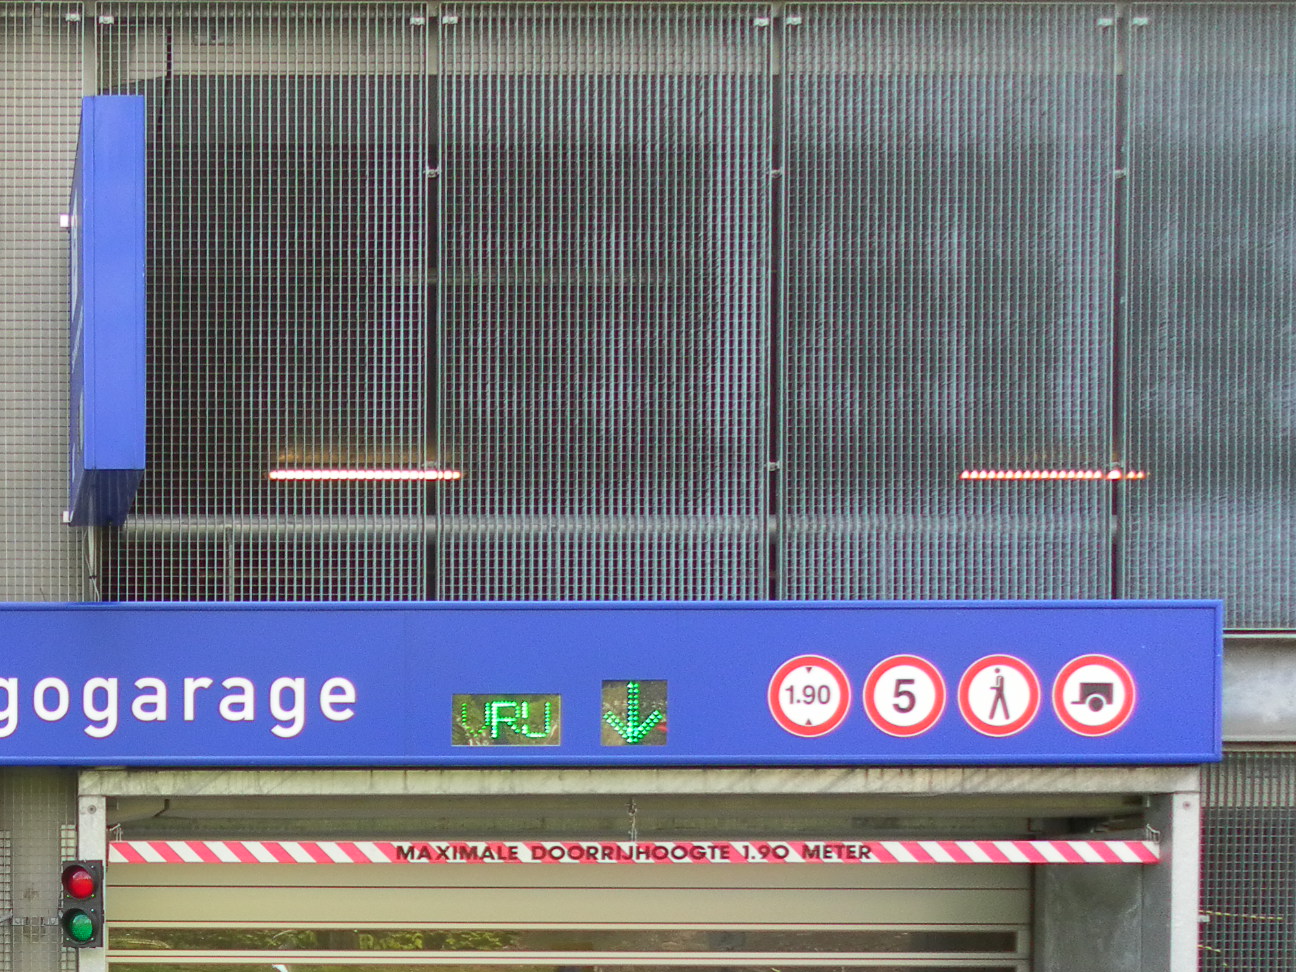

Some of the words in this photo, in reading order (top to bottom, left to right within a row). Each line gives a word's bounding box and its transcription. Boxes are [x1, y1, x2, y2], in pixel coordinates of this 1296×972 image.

[785, 684, 831, 705] 1.90
[892, 678, 916, 714] 5
[396, 845, 519, 861] MAXIMALE
[531, 844, 730, 861] DOORRIJHOOGTE
[742, 844, 790, 860] 1.90
[802, 844, 872, 860] METER
